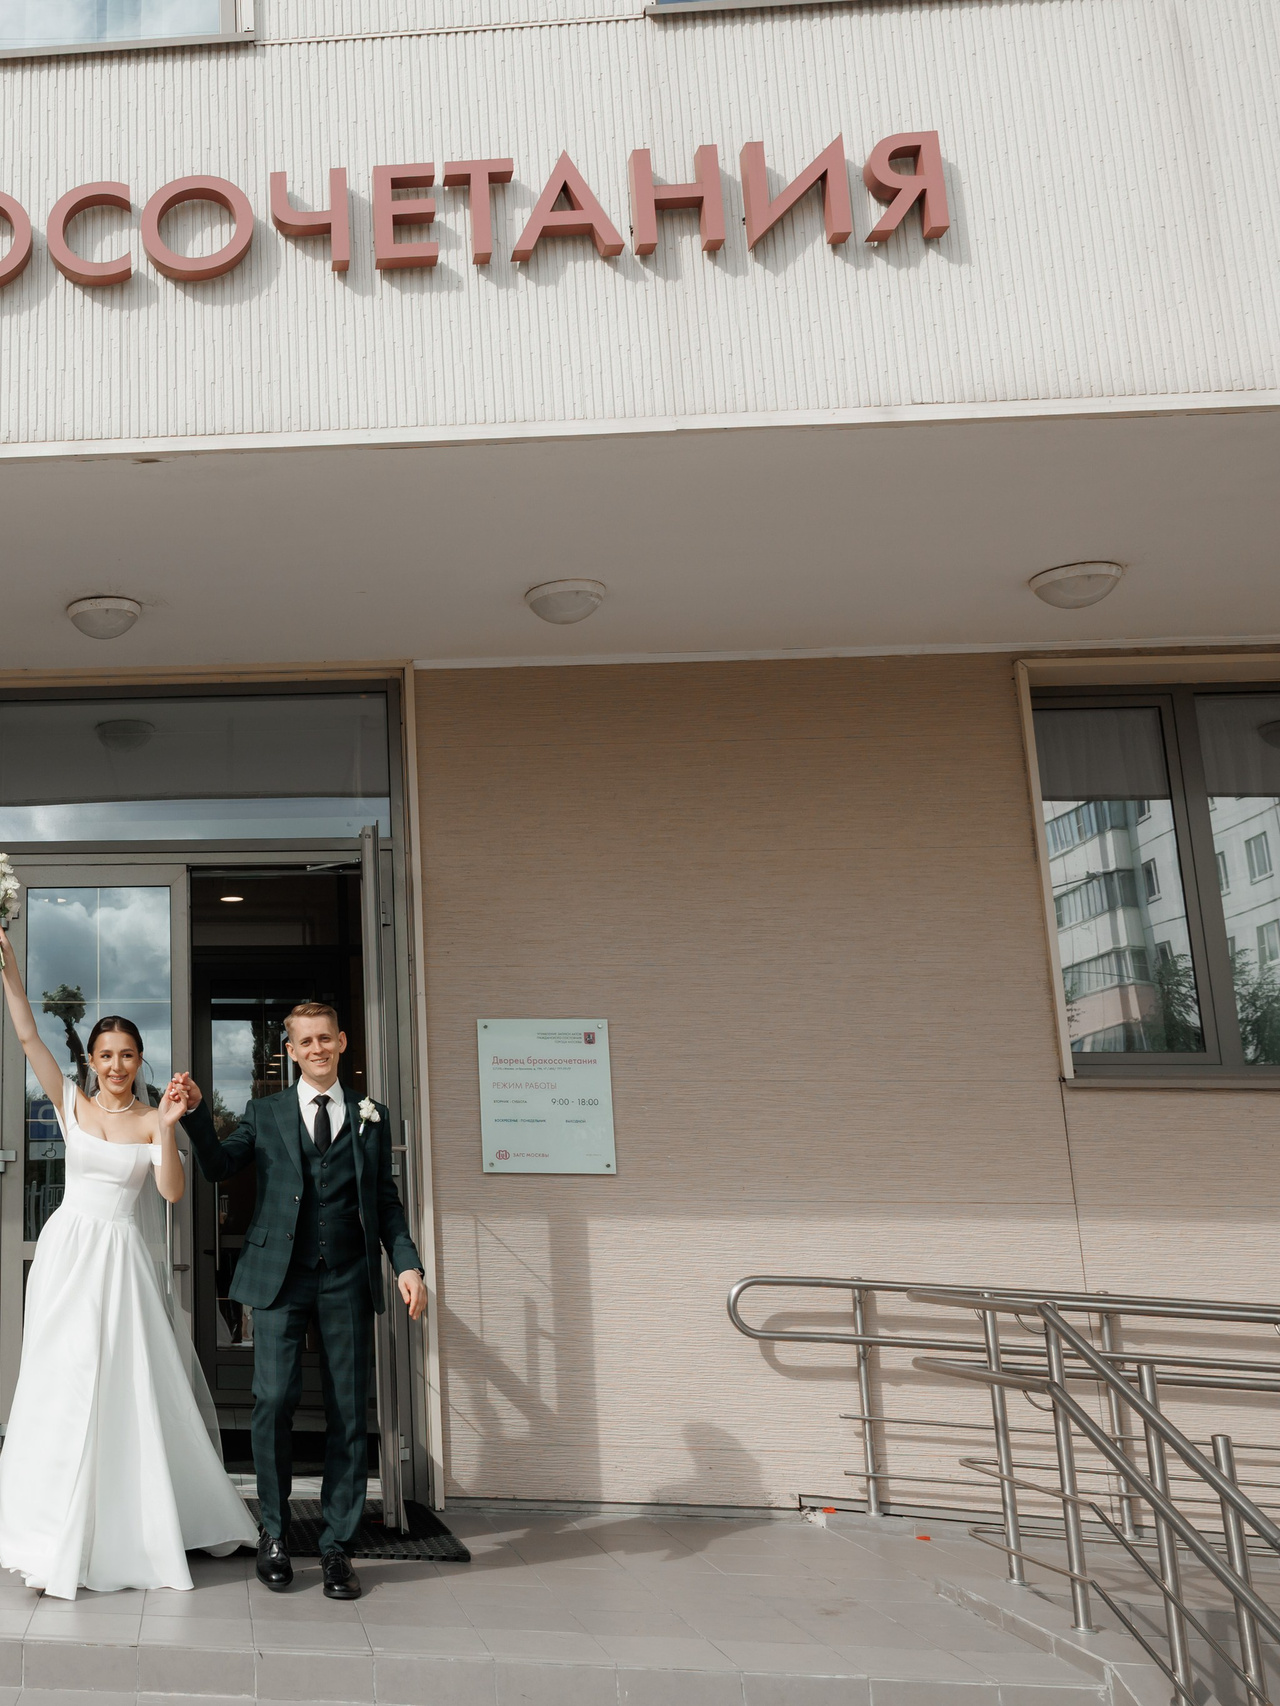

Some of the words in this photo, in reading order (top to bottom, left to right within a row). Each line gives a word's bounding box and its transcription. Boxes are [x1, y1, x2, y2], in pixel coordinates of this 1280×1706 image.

[492, 1056, 525, 1066] Дворец
[527, 1056, 597, 1066] бракосочетания
[492, 1082, 523, 1090] РЕЖИМ
[525, 1082, 557, 1090] РАБОТЫ
[551, 1098, 570, 1106] 9:00
[577, 1098, 599, 1106] 18:00
